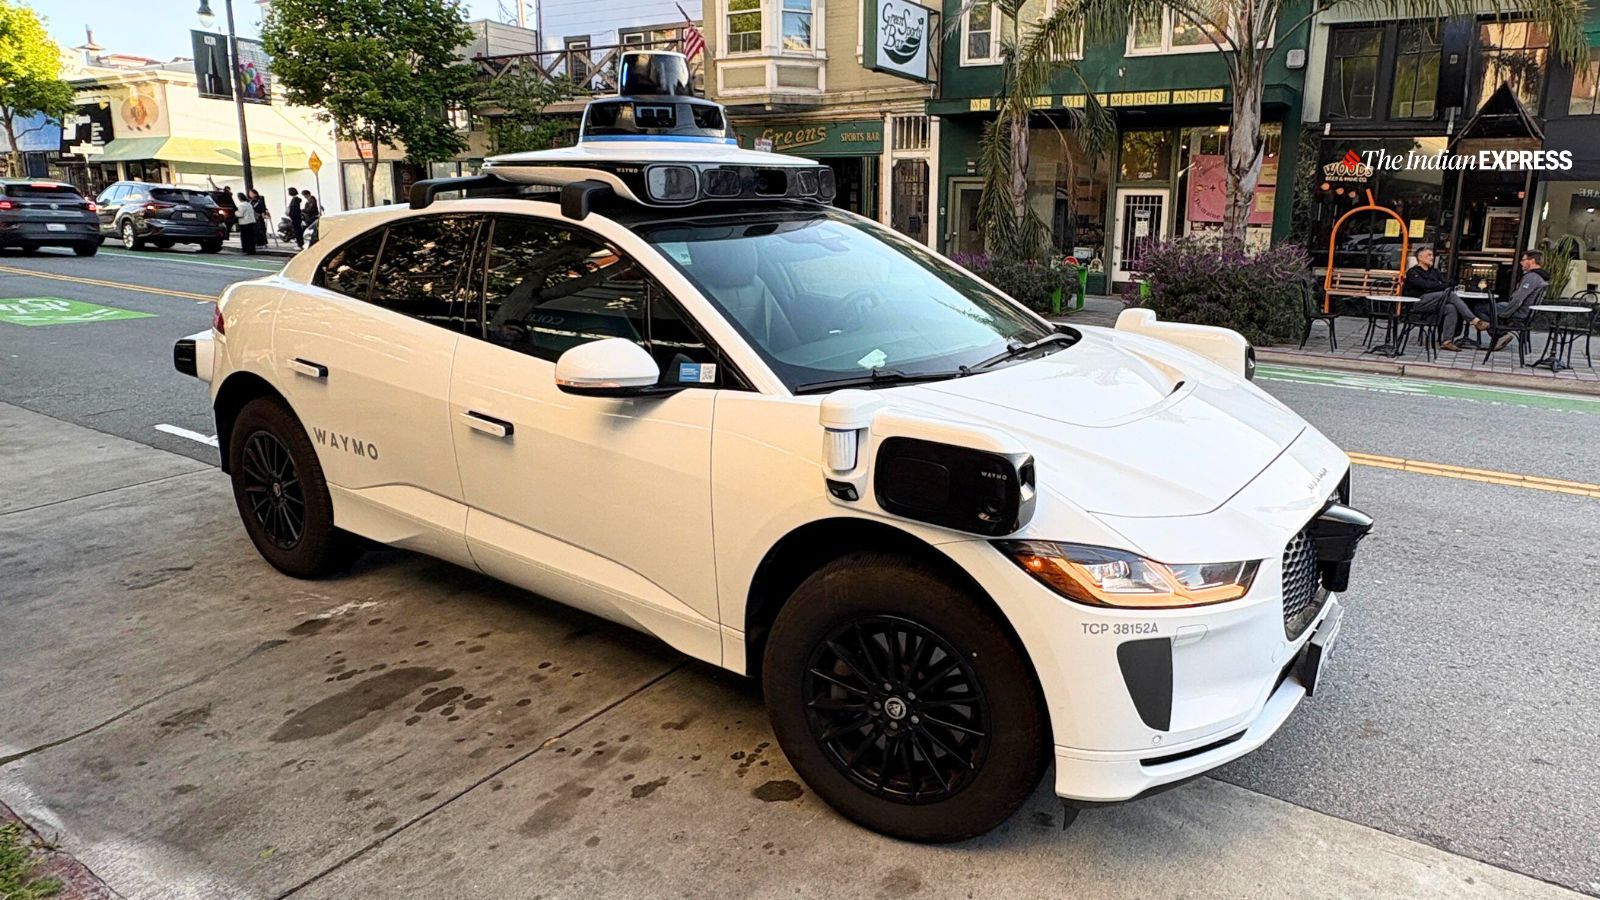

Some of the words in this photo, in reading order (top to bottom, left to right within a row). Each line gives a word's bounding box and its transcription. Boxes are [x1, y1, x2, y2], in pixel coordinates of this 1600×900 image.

[884, 24, 904, 49] Bar
[1063, 95, 1106, 108] WIE
[762, 126, 827, 145] Greens
[840, 132, 864, 141] SPORTS
[867, 131, 879, 141] BAR
[313, 427, 379, 461] WAYMO
[981, 471, 1008, 480] WAYMO
[1081, 622, 1109, 634] TCP
[1113, 622, 1158, 635] 38152A
